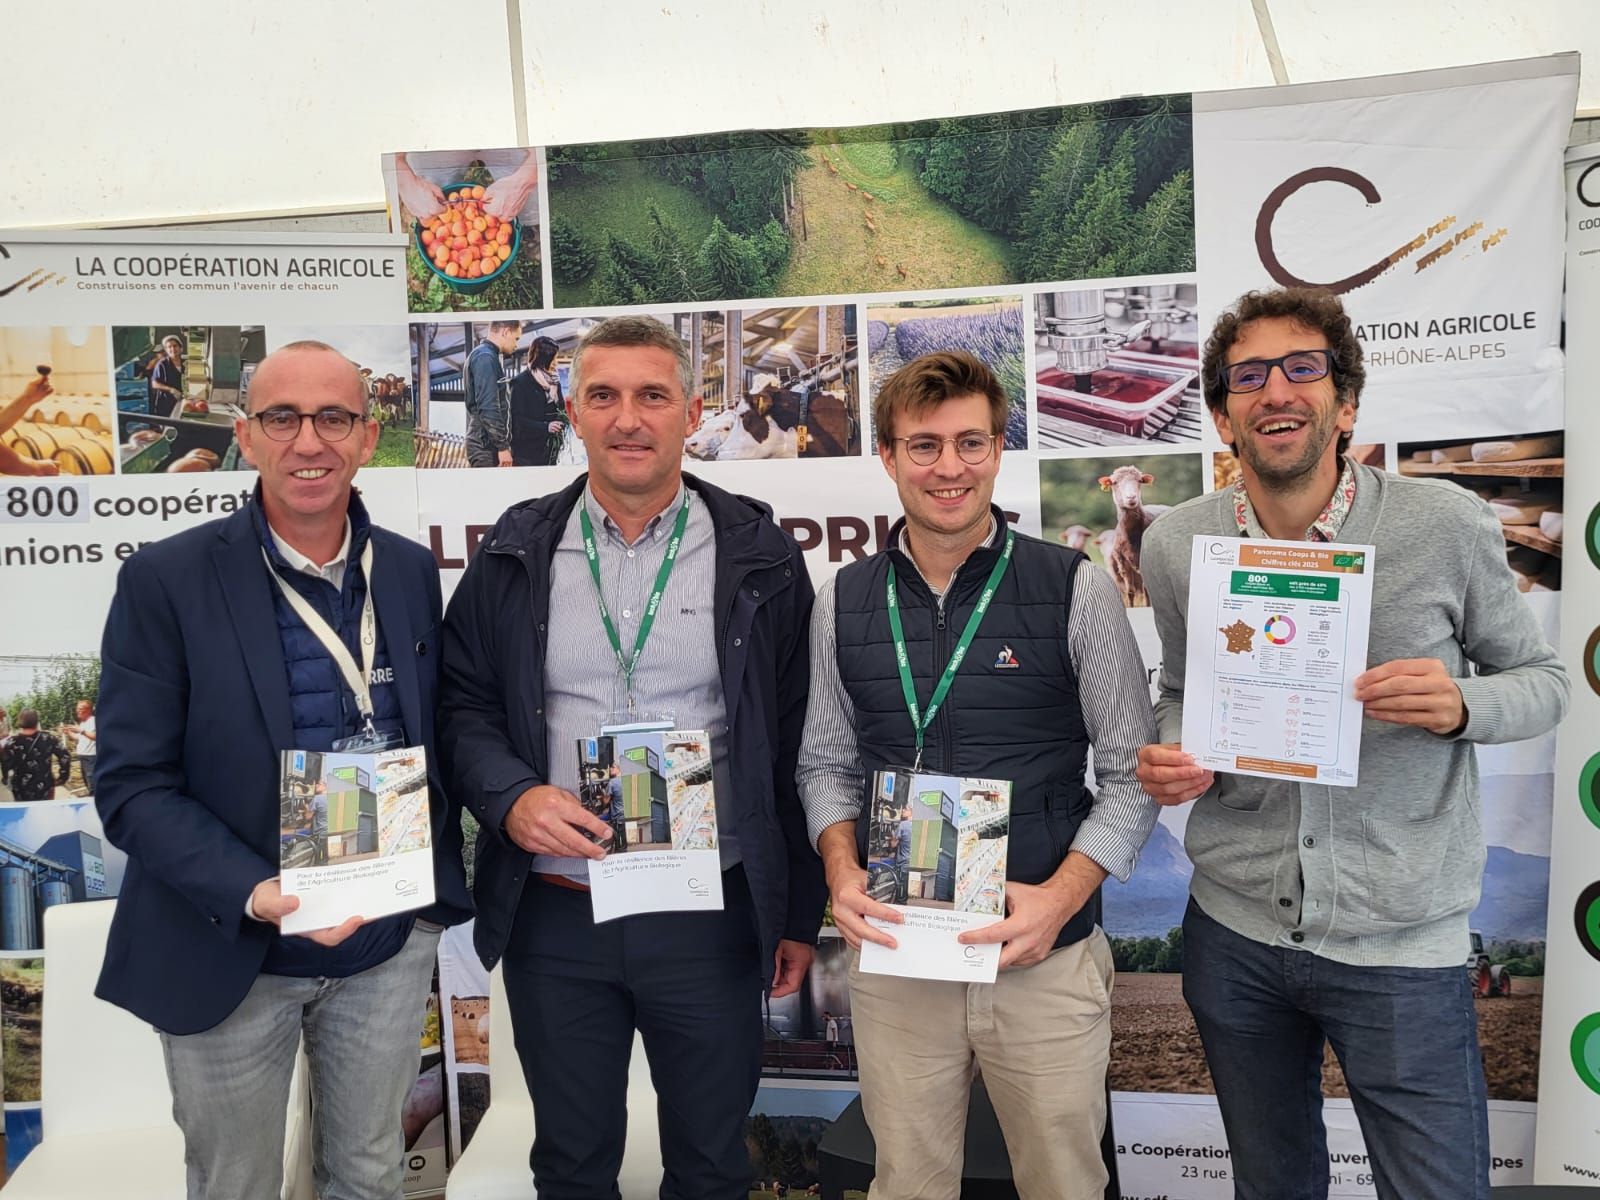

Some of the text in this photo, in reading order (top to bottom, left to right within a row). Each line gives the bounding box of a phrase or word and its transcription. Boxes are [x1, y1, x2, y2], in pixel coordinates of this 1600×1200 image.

[76, 253, 395, 278] LA COOPÉRATION AGRICOLE
[76, 281, 157, 290] Construisons
[178, 283, 230, 291] commun
[233, 281, 276, 291] l'avenir
[280, 281, 294, 291] de
[297, 281, 339, 291] chacun
[1355, 311, 1536, 342] ATION AGRICOLE
[1363, 343, 1506, 368] -RHÔNE-ALPES
[7, 486, 256, 522] 800 coopérat
[0, 538, 103, 566] nions
[429, 524, 498, 569] LE
[1253, 548, 1287, 557] Panorama
[1247, 574, 1268, 584] 800
[1330, 1153, 1370, 1165] uver
[1492, 1156, 1524, 1170] pes
[1181, 1166, 1198, 1178] 23
[1203, 1168, 1228, 1180] rue
[1357, 1173, 1375, 1186] 69
